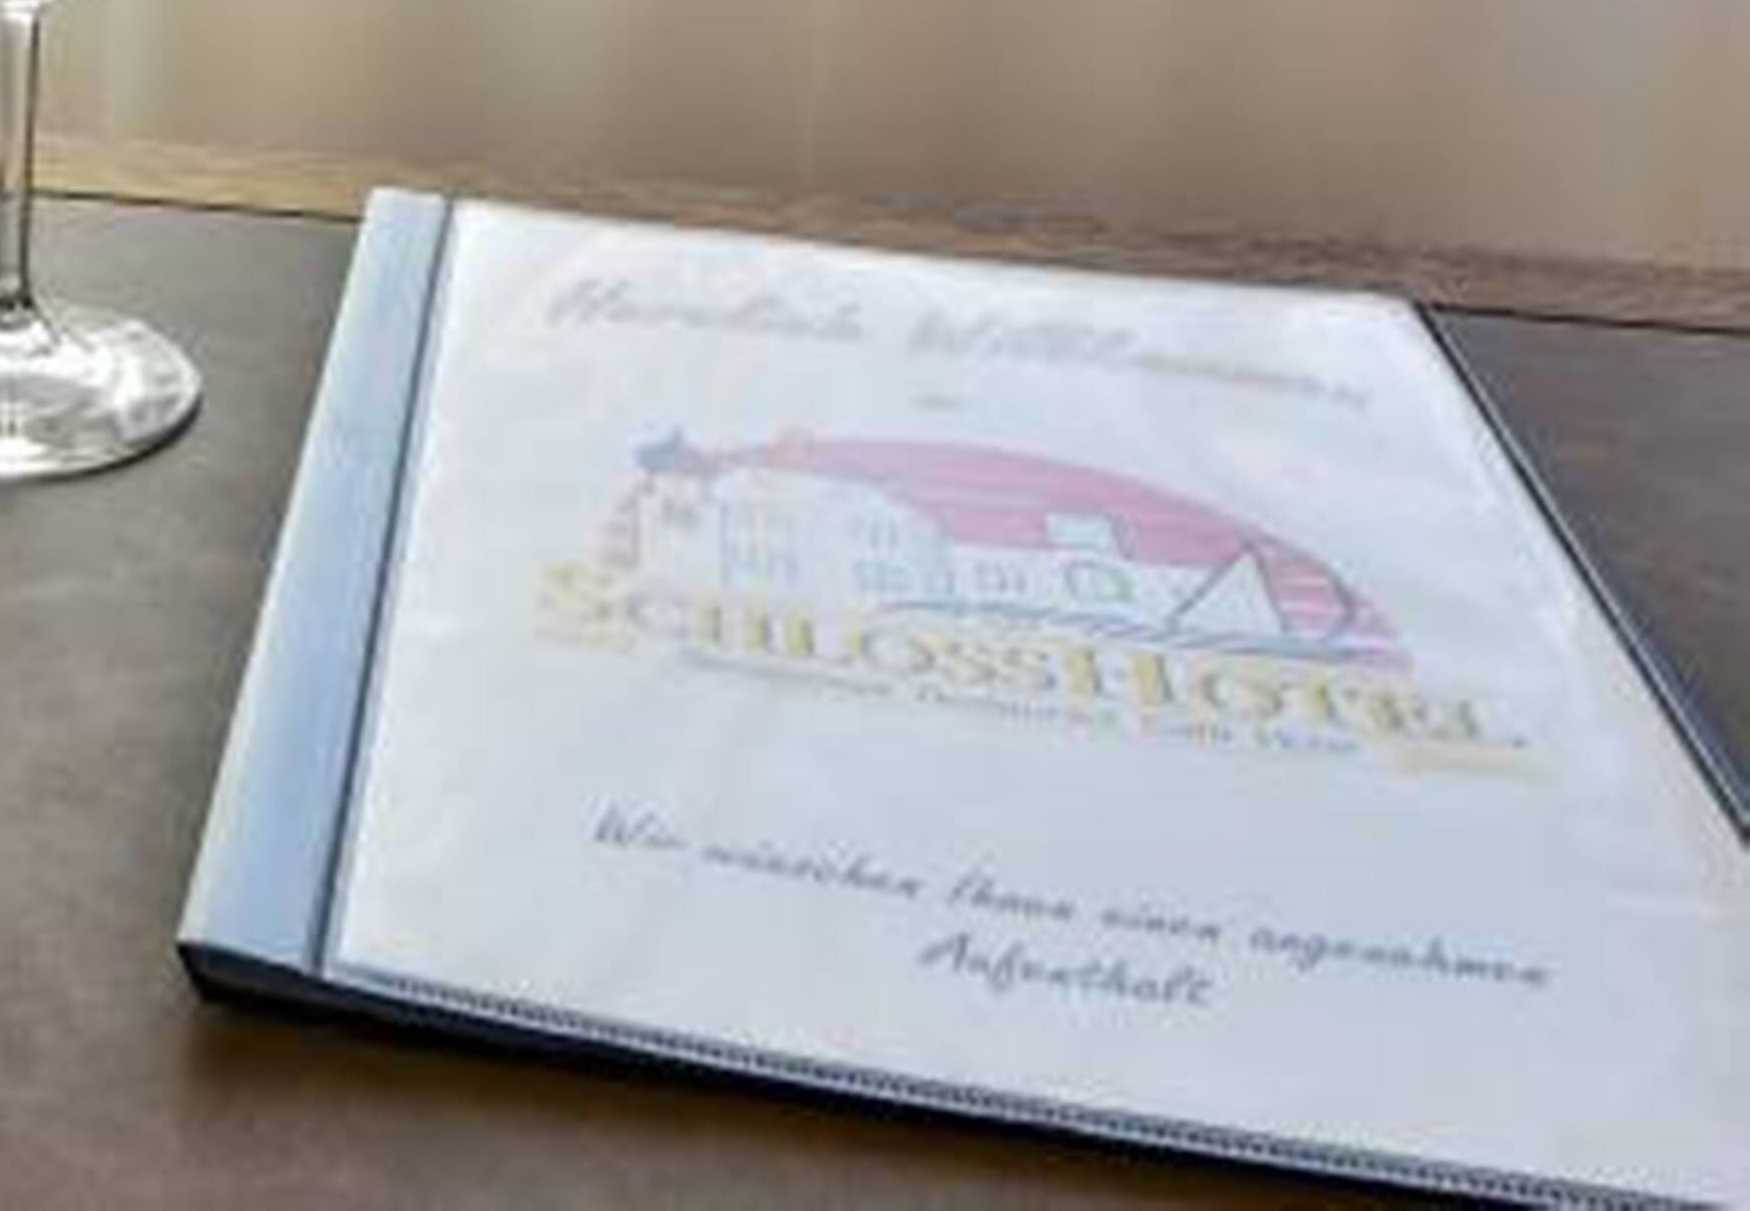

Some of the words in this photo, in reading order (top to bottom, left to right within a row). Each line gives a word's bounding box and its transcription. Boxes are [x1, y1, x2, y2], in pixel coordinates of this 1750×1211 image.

[595, 805, 688, 848] Wir
[701, 840, 921, 901] wünschen
[950, 866, 1076, 922] Ihnen
[1100, 902, 1221, 942] einen
[1249, 926, 1547, 986] angenehmen
[918, 933, 1216, 1004] Aufenthalt
